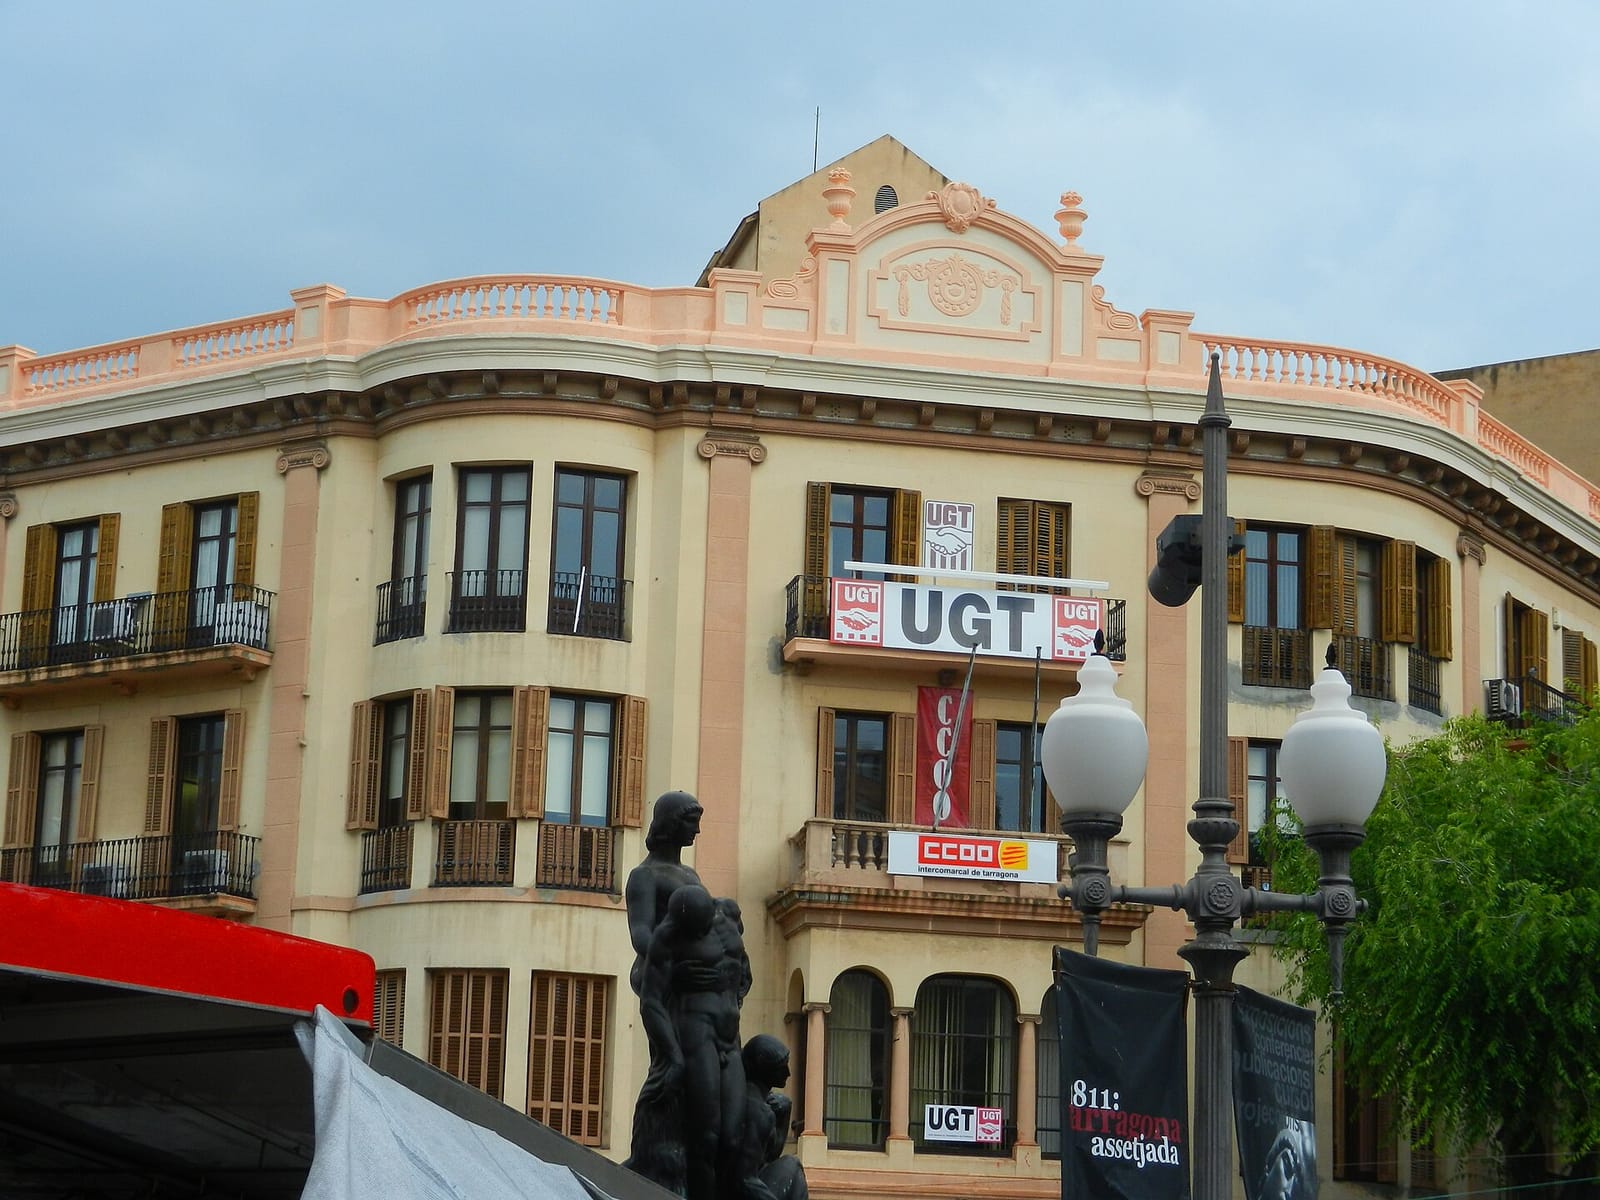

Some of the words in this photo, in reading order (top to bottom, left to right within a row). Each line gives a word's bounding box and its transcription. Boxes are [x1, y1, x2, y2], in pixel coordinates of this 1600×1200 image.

[926, 503, 972, 529] UGT
[844, 585, 879, 605] UGT
[900, 587, 1036, 653] UGT
[1063, 602, 1098, 622] UGT
[932, 694, 953, 822] CCOO
[923, 841, 993, 863] CCOO
[917, 866, 970, 877] intercomarcal
[971, 868, 981, 877] de
[982, 869, 1019, 879] tarragona
[1070, 1079, 1120, 1111] 811:
[928, 1106, 975, 1131] UGT
[982, 1111, 1001, 1121] UGT
[1091, 1133, 1180, 1169] assetjada
